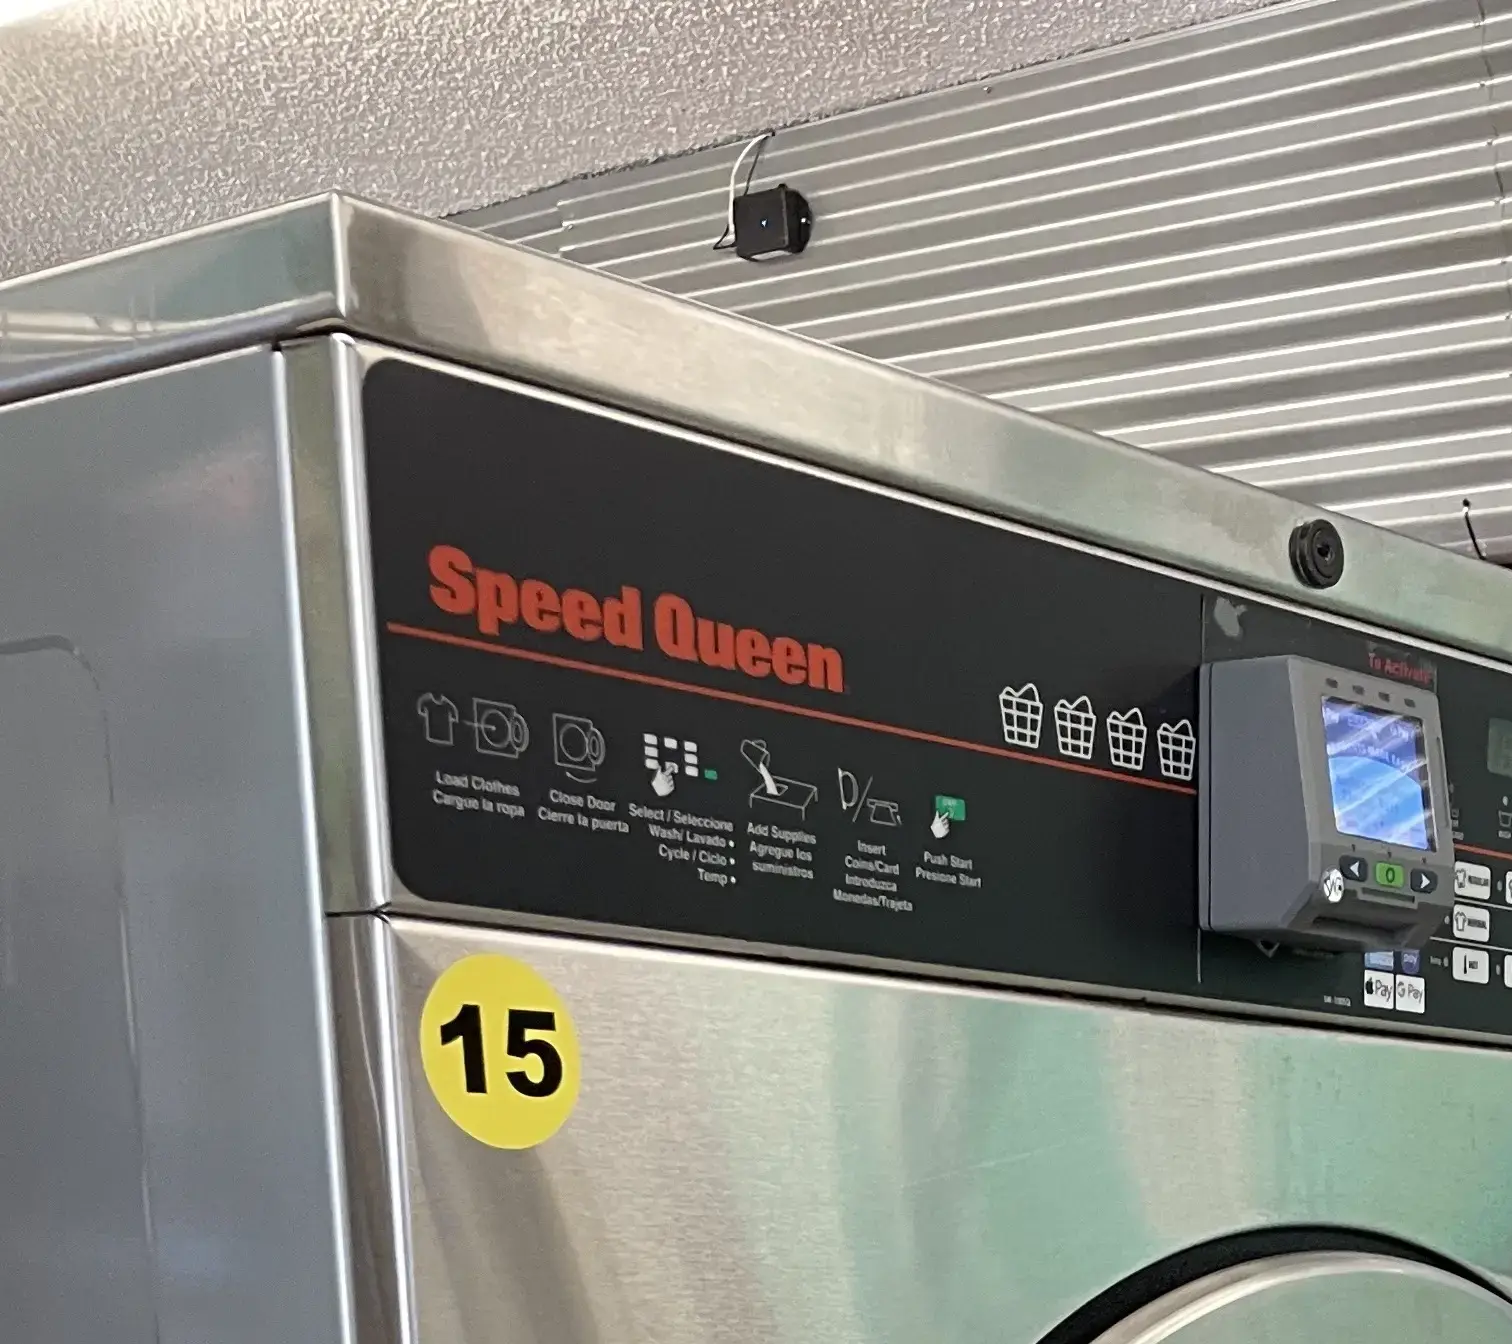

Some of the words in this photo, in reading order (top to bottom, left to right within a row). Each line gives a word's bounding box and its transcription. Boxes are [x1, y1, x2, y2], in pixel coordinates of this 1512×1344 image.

[428, 544, 644, 651] Speed
[654, 592, 844, 694] Queen
[436, 770, 469, 788] Load
[471, 775, 520, 796] Clothes
[482, 798, 493, 812] la
[550, 789, 583, 807] Close
[587, 795, 616, 812] Door
[537, 806, 575, 824] Cierre
[577, 813, 588, 827] la
[592, 817, 629, 833] puerta
[628, 803, 665, 822] Select
[673, 810, 734, 832] Seleccione
[747, 822, 768, 837] Add
[658, 844, 689, 861] Cycle
[699, 850, 727, 866] Ciclo
[750, 841, 794, 860] Agregue
[857, 840, 886, 856] Insert
[924, 850, 948, 866] Push
[950, 855, 973, 871] Start
[697, 867, 728, 887] Temp
[1375, 979, 1392, 1002] Pay
[1408, 984, 1423, 1004] Pay
[440, 1004, 563, 1098] 15
